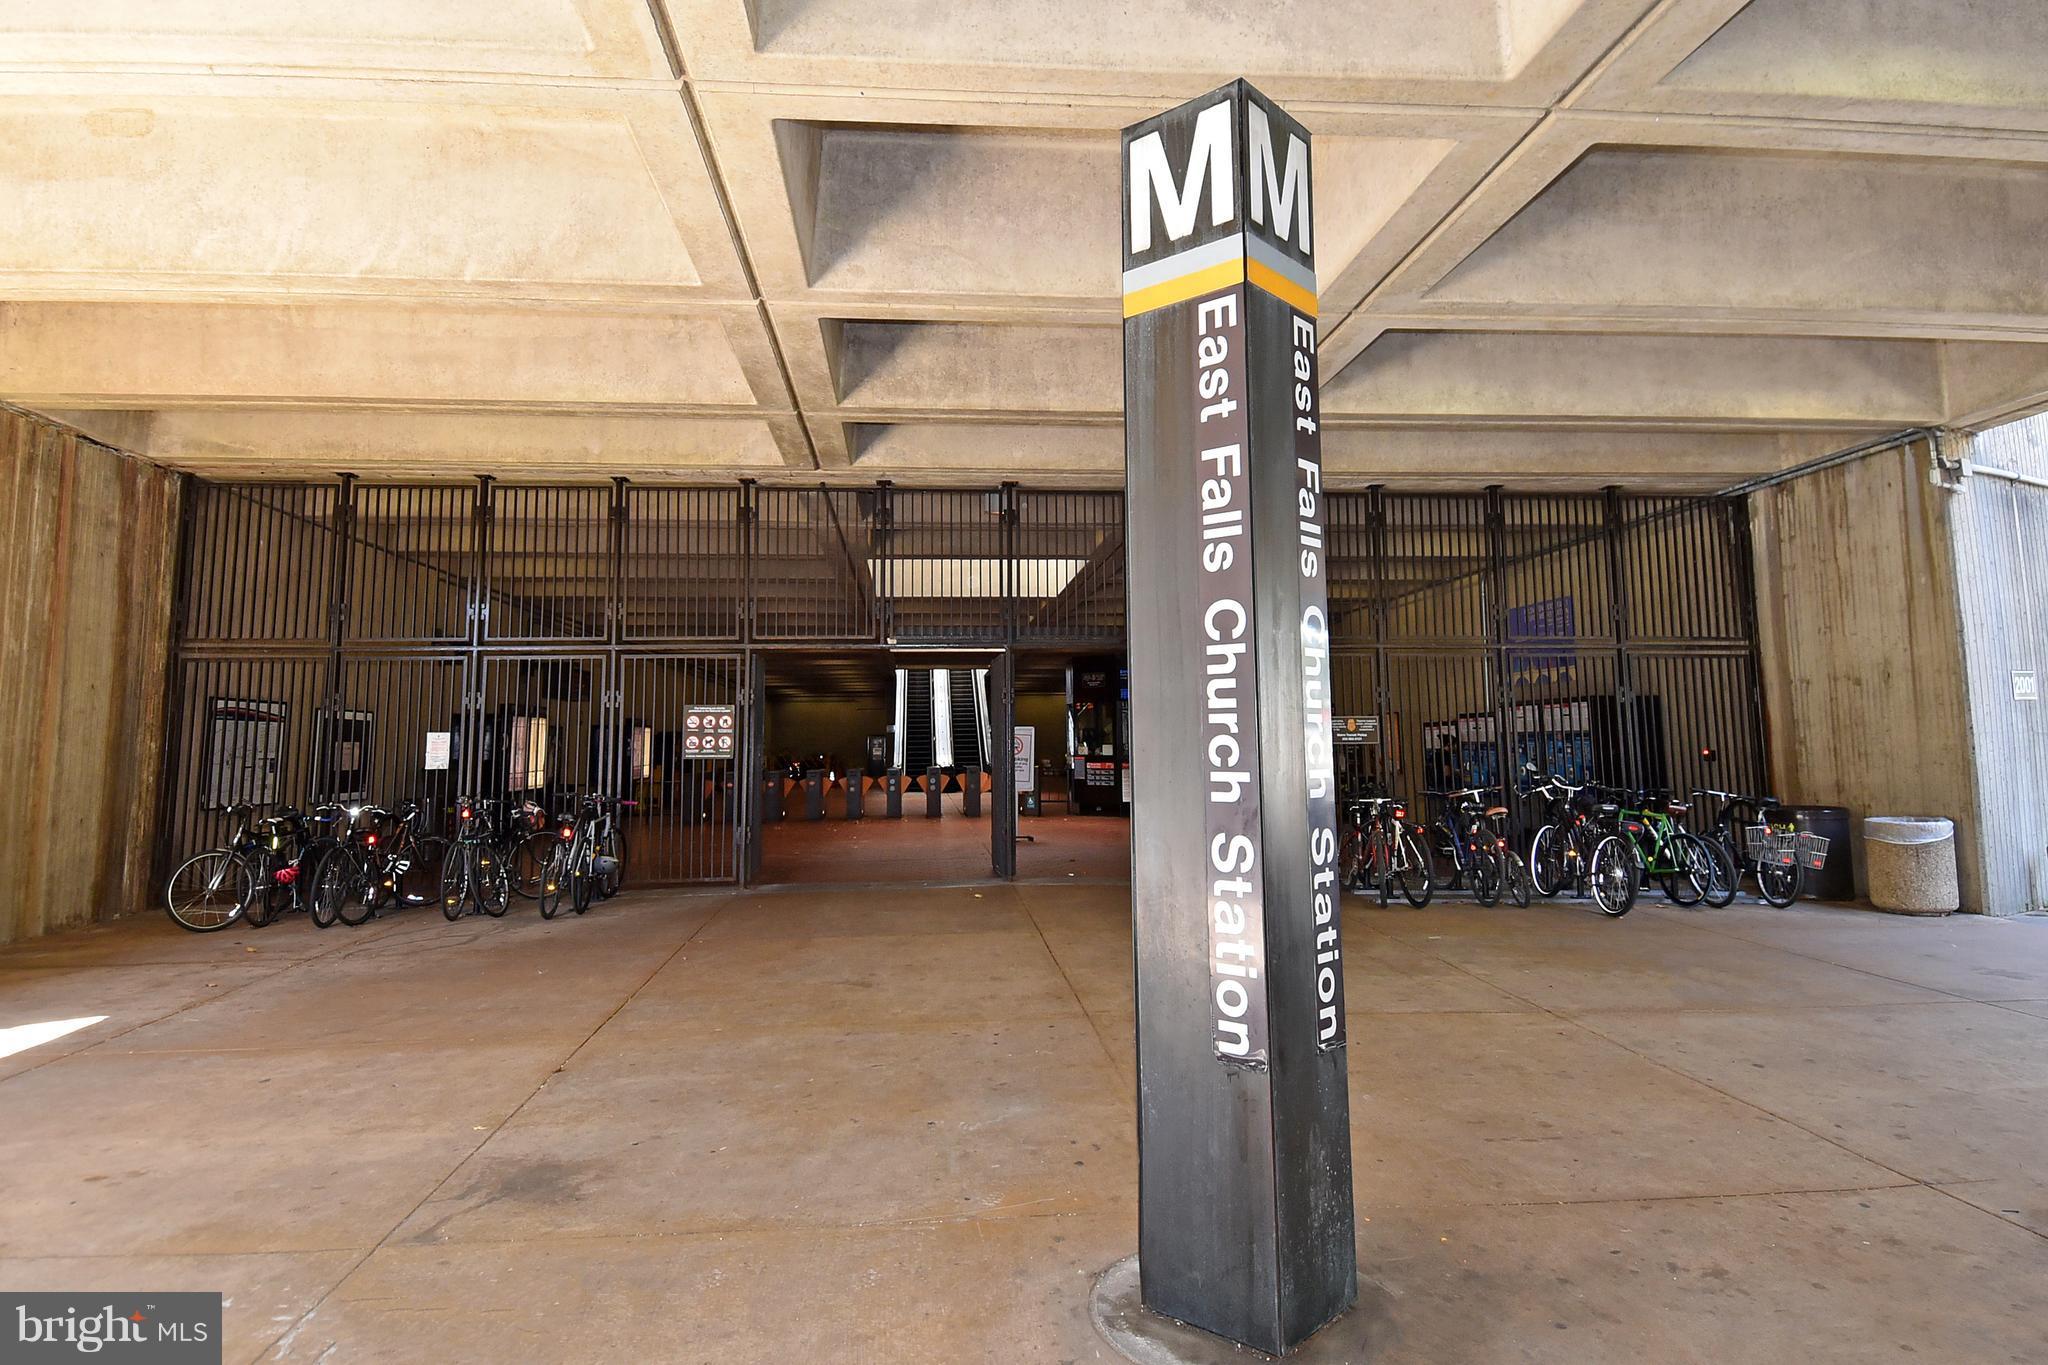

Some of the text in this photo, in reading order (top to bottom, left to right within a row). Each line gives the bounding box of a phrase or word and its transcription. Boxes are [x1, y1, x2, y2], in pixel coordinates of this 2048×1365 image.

[1129, 99, 1234, 255] M
[1247, 99, 1310, 255] M
[1197, 293, 1257, 1056] East Falls Church Station
[1293, 315, 1339, 1044] East Falls Church Station
[2015, 676, 2034, 693] 2001
